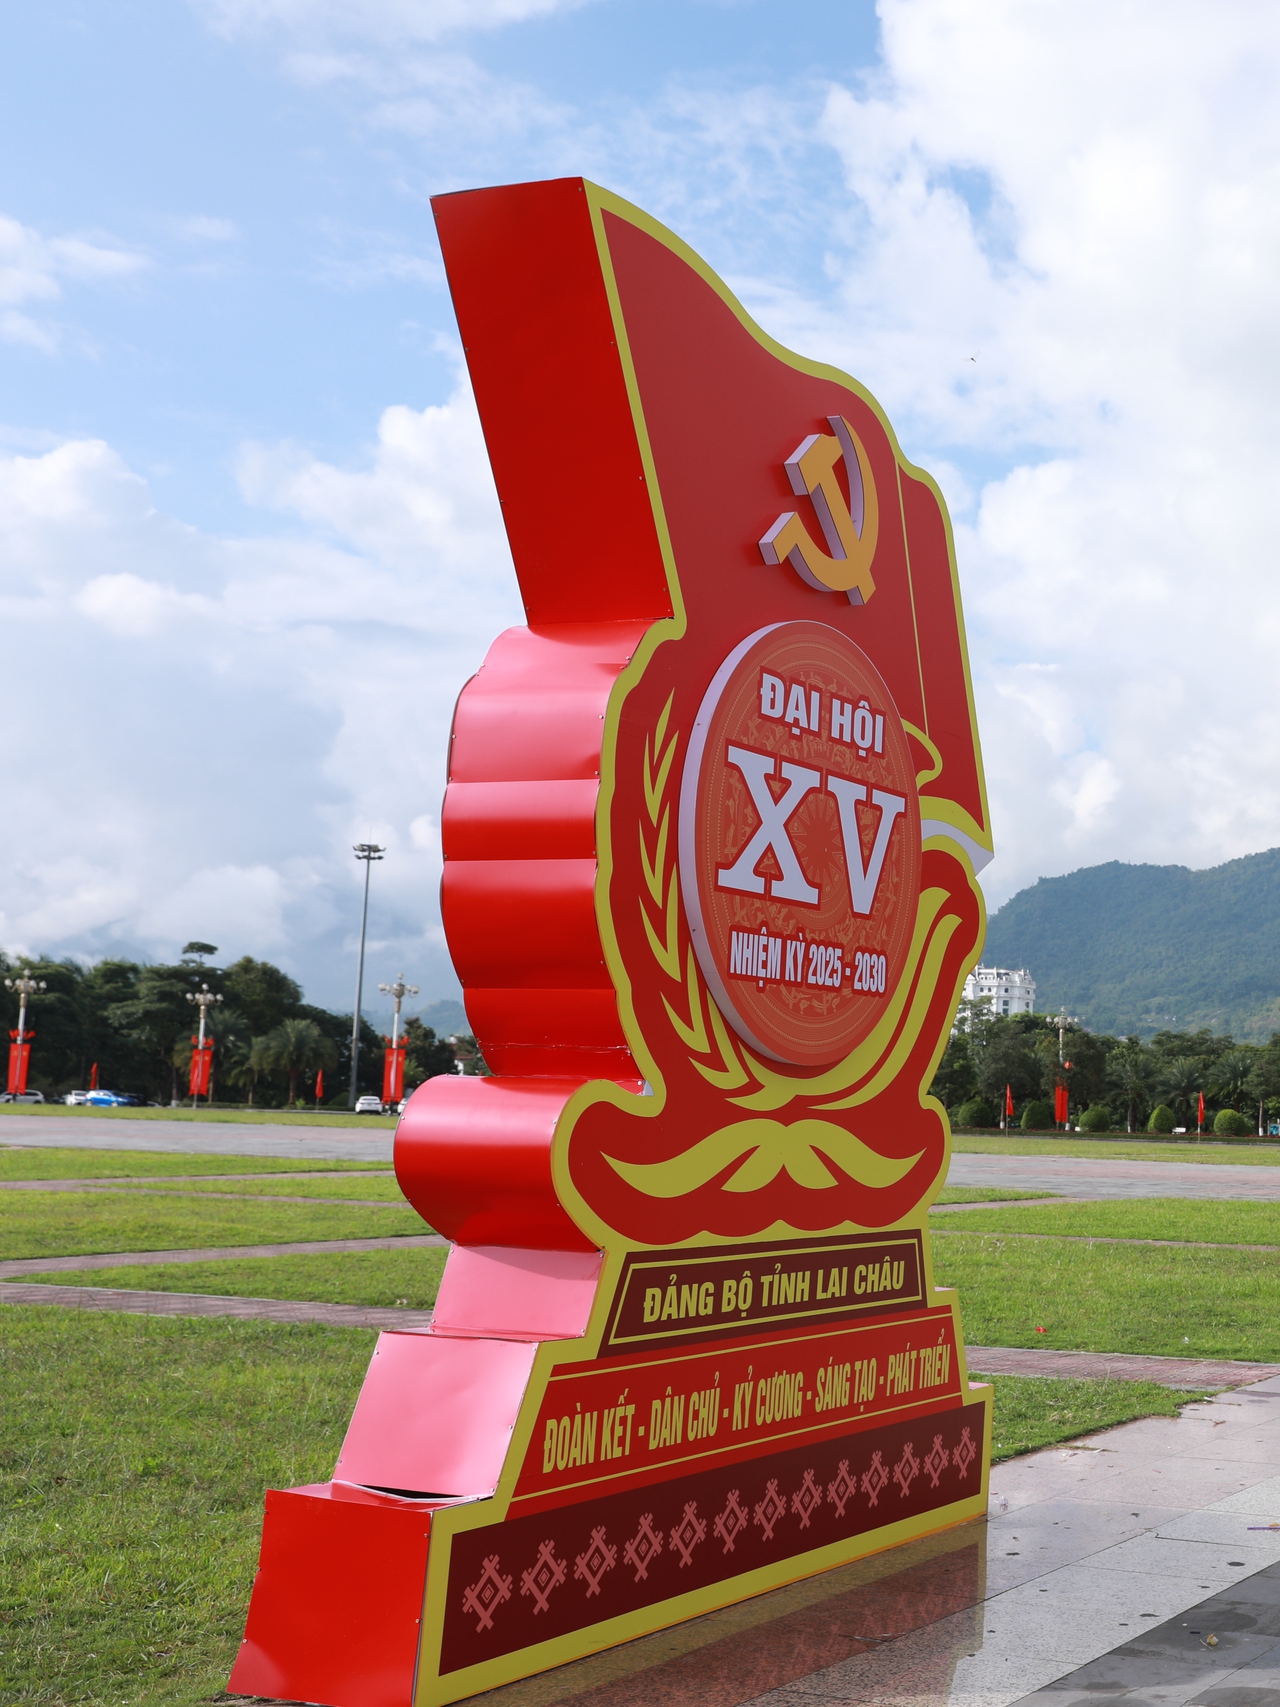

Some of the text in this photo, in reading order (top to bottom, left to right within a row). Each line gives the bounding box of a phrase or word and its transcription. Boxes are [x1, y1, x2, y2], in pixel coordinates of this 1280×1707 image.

[760, 672, 885, 758] ĐẠI HỘI
[717, 745, 906, 915] XV
[729, 926, 782, 988] NHIỆM
[785, 932, 806, 982] KỲ
[807, 943, 843, 988] 2025
[853, 951, 886, 994] 2030
[643, 1255, 905, 1323] ĐẢNG BỘ TỈNH LAI CHÂU
[542, 1402, 598, 1474] ĐOÀN
[600, 1388, 636, 1461] KẾT
[648, 1386, 685, 1450] DÂN
[687, 1371, 721, 1442] CHỦ
[732, 1365, 754, 1431] KỶ
[755, 1369, 804, 1426] CƯƠNG
[814, 1356, 851, 1413] SÁNG
[853, 1357, 877, 1412] TẠO
[886, 1342, 918, 1397] PHÁT
[919, 1328, 951, 1389] TRIỂN
